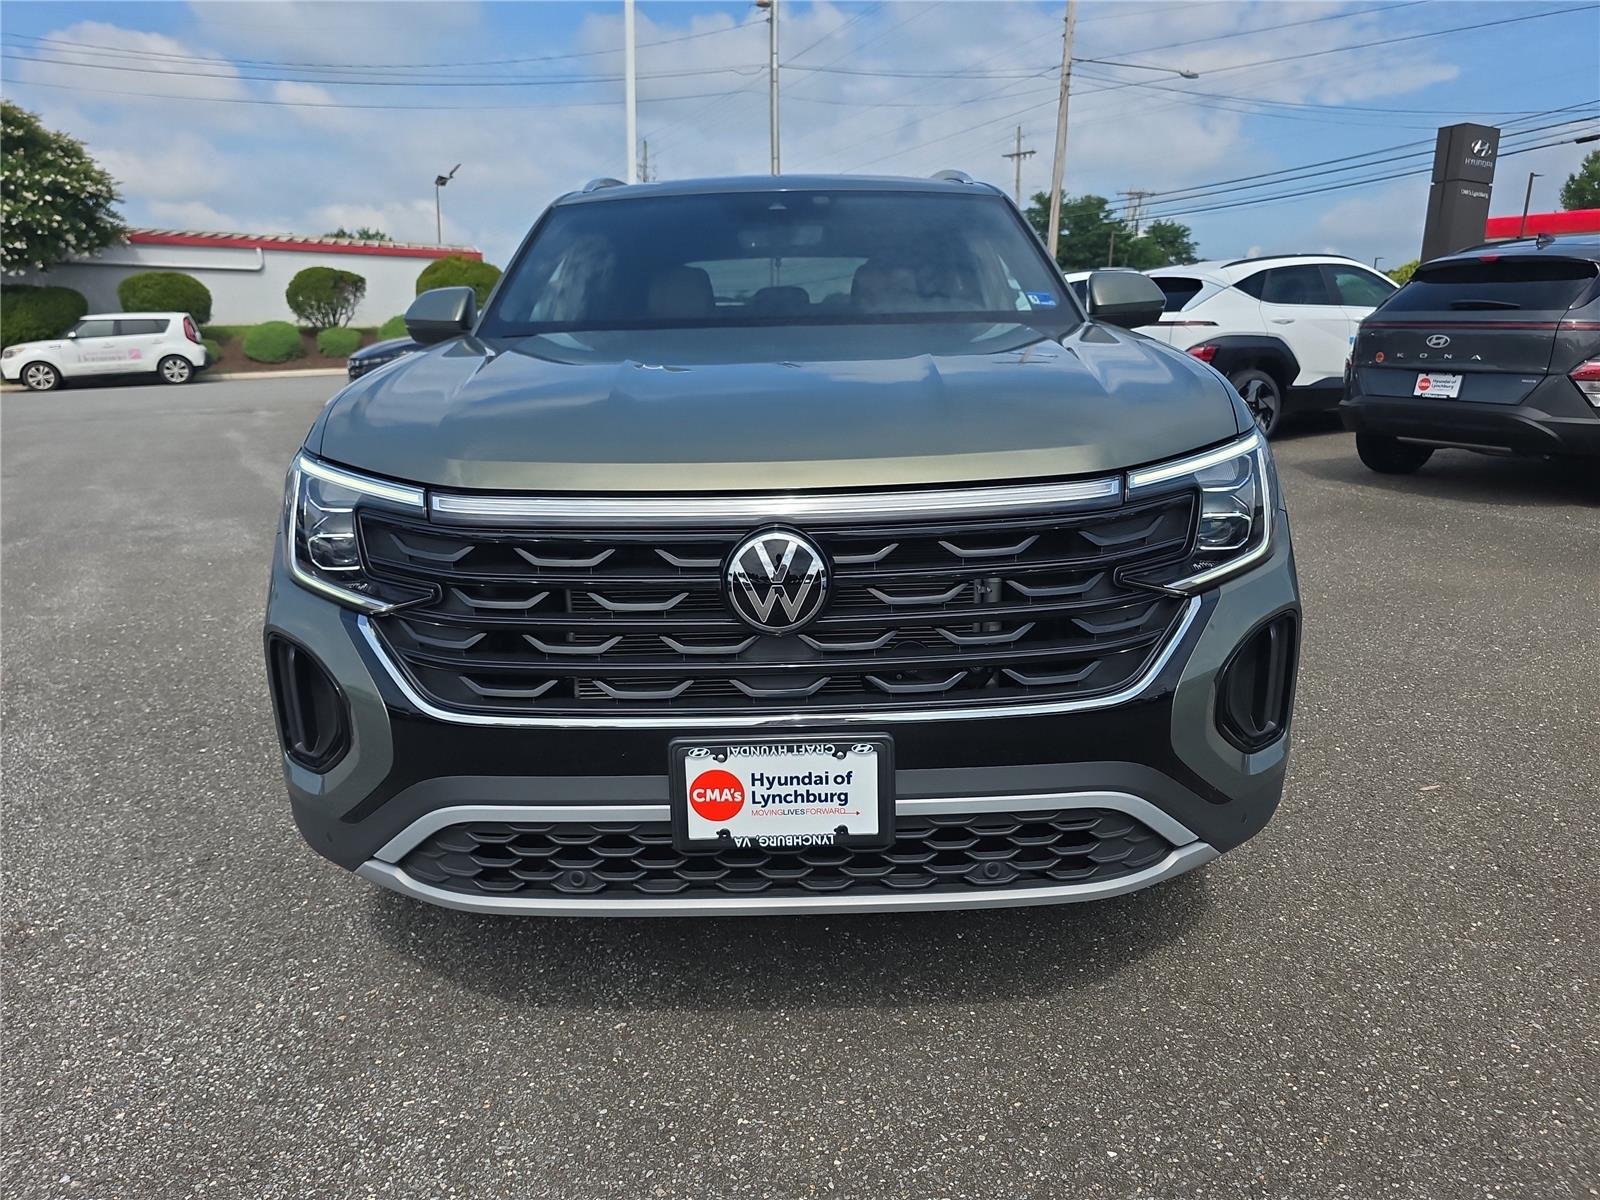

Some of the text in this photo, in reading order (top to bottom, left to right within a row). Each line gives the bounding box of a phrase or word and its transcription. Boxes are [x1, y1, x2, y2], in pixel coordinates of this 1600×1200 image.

[1396, 352, 1482, 361] KONA
[727, 744, 836, 757] CRAFT HYUNDAI
[750, 771, 853, 790] Hyundai of
[692, 788, 742, 802] CMA's
[751, 789, 849, 808] Lynchburg
[733, 834, 834, 848] LYNCHBURG, VA
